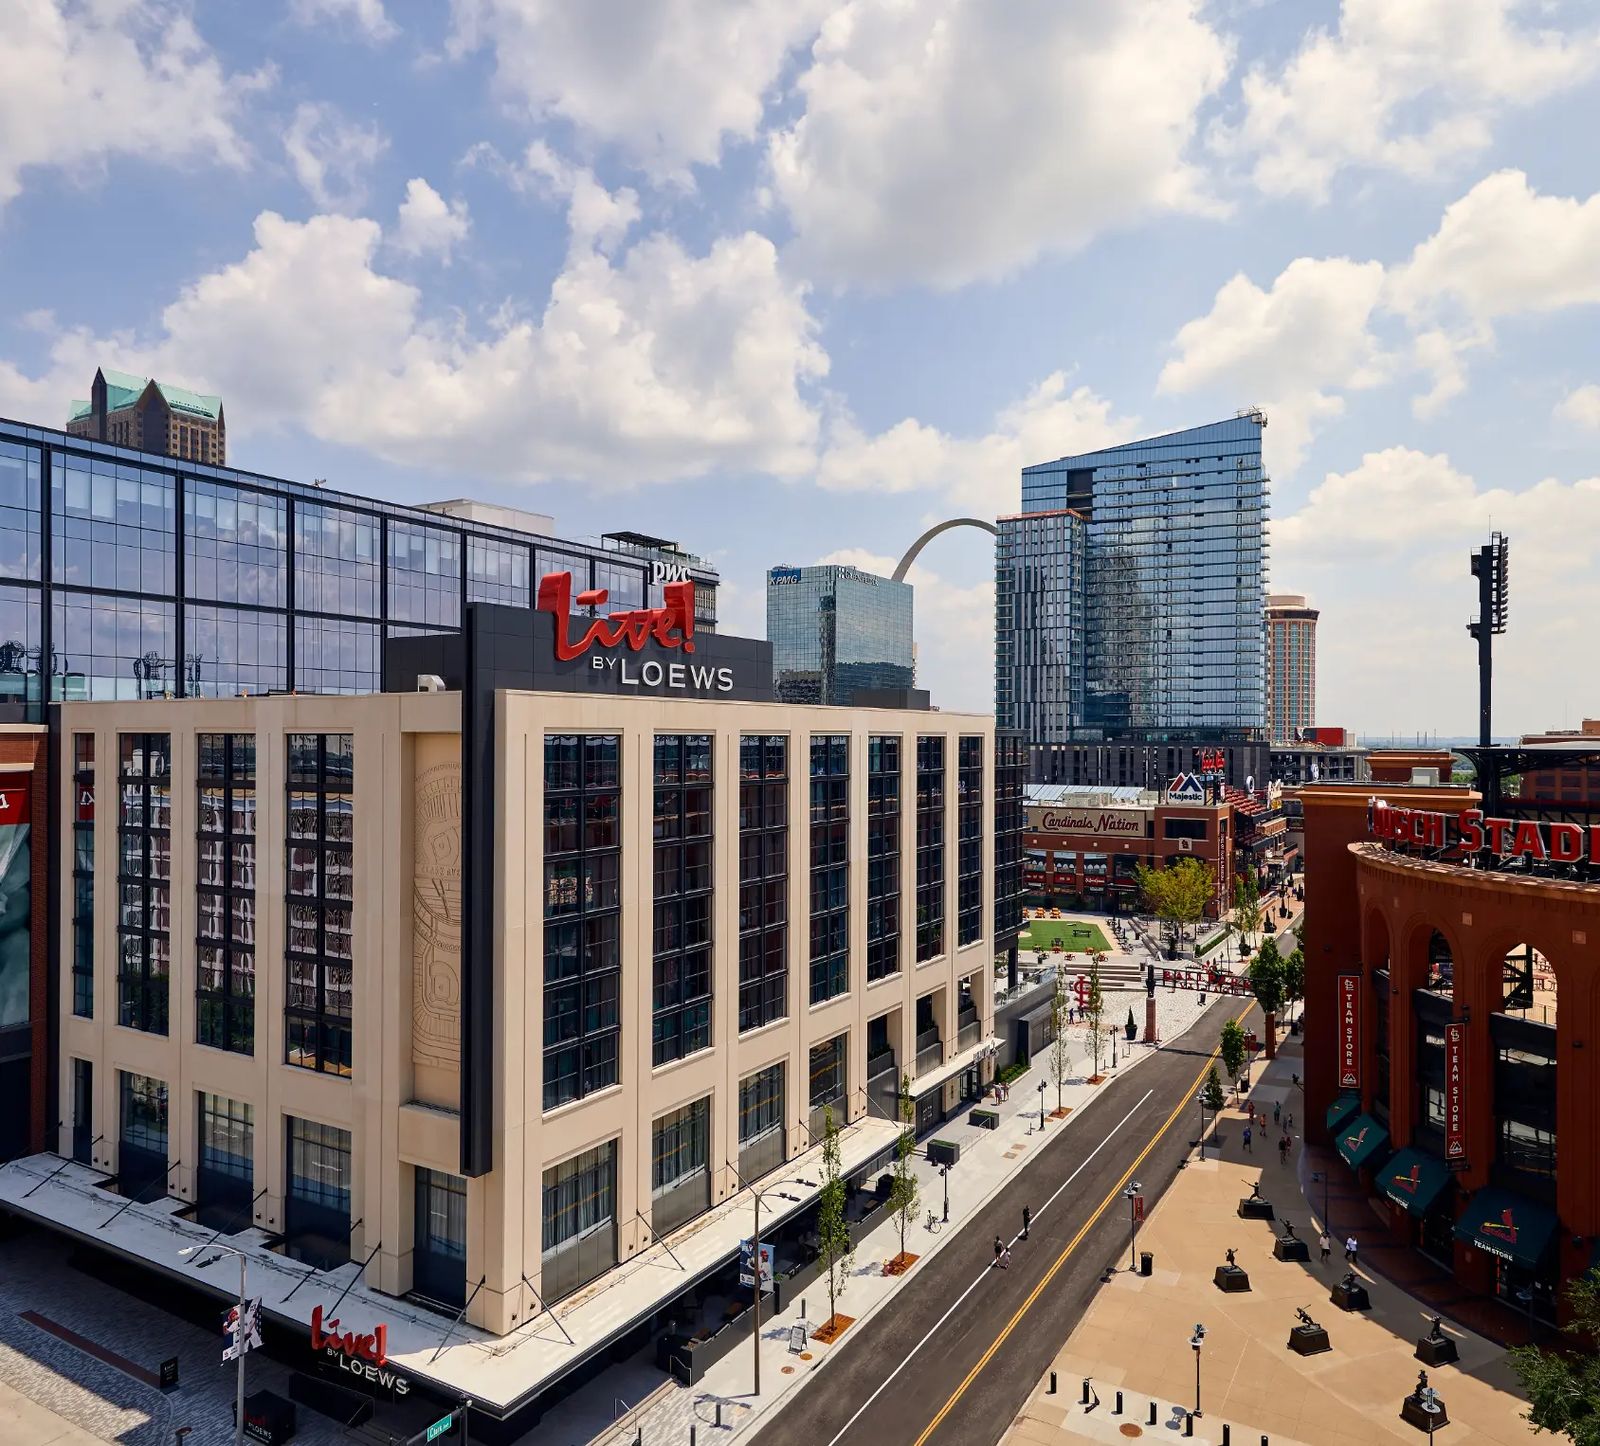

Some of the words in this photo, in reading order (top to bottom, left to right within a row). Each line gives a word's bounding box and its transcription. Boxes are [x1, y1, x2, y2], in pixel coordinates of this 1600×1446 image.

[651, 560, 691, 585] pwc
[769, 575, 798, 585] KPMG
[537, 571, 696, 661] Live!
[592, 656, 617, 670] BY
[621, 658, 734, 692] LOEWS
[1168, 793, 1203, 802] Majestic
[1043, 811, 1094, 831] Cardinals
[1093, 813, 1139, 833] Nation
[1345, 993, 1354, 1025] TEAM
[1345, 1027, 1354, 1066] STORE
[1451, 1046, 1459, 1082] TEAM
[1451, 1086, 1459, 1132] STORE
[1473, 1239, 1491, 1253] TEAM
[1491, 1248, 1513, 1262] STORE
[311, 1304, 387, 1368] Live!
[326, 1347, 340, 1358] BY
[339, 1353, 410, 1395] LOEWS
